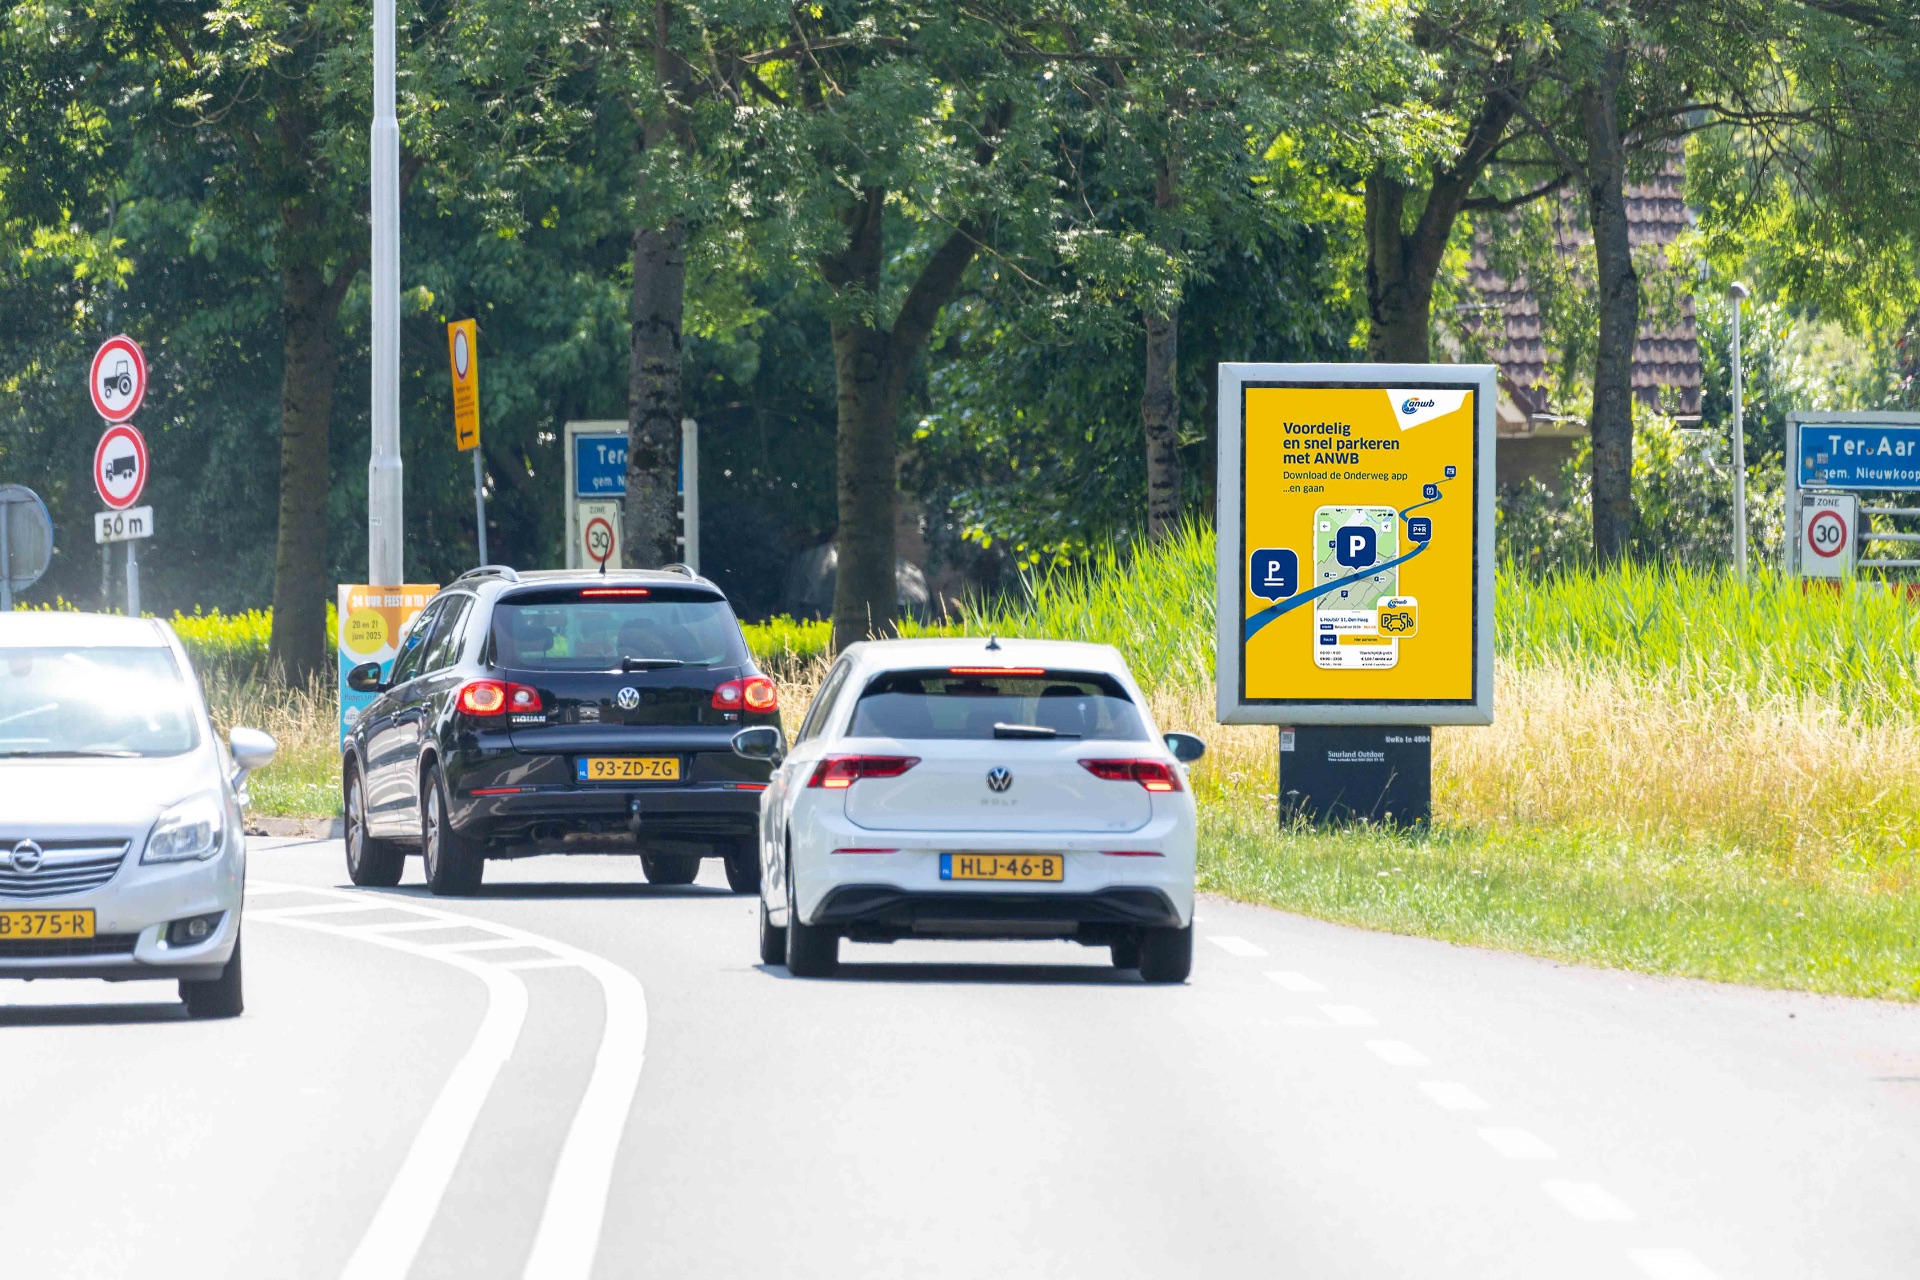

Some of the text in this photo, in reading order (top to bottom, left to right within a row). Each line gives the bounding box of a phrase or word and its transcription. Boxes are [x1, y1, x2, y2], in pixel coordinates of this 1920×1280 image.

[1283, 422, 1351, 437] Voordelig
[1283, 437, 1400, 452] en snel parkeren
[1828, 434, 1915, 457] Ter Aar
[596, 445, 625, 465] Ter
[1283, 452, 1360, 464] met ANWB
[1283, 471, 1408, 481] Download de Onderweg app
[1303, 485, 1325, 494] gaan
[1817, 498, 1841, 508] ZONE
[103, 513, 143, 537] 50 m
[591, 531, 609, 548] 30
[1816, 524, 1840, 544] 30
[1349, 535, 1366, 558] P
[1268, 560, 1281, 579] P
[352, 595, 364, 607] 24
[366, 596, 382, 607] UUR
[384, 595, 404, 607] FEEST
[352, 620, 379, 629] 20 en 21
[352, 631, 382, 642] juni 2025
[511, 715, 546, 723] TIGUAN
[1327, 750, 1356, 758] Suurland
[594, 761, 673, 776] 93-ZD-ZG
[959, 858, 1055, 877] HLJ-46-B
